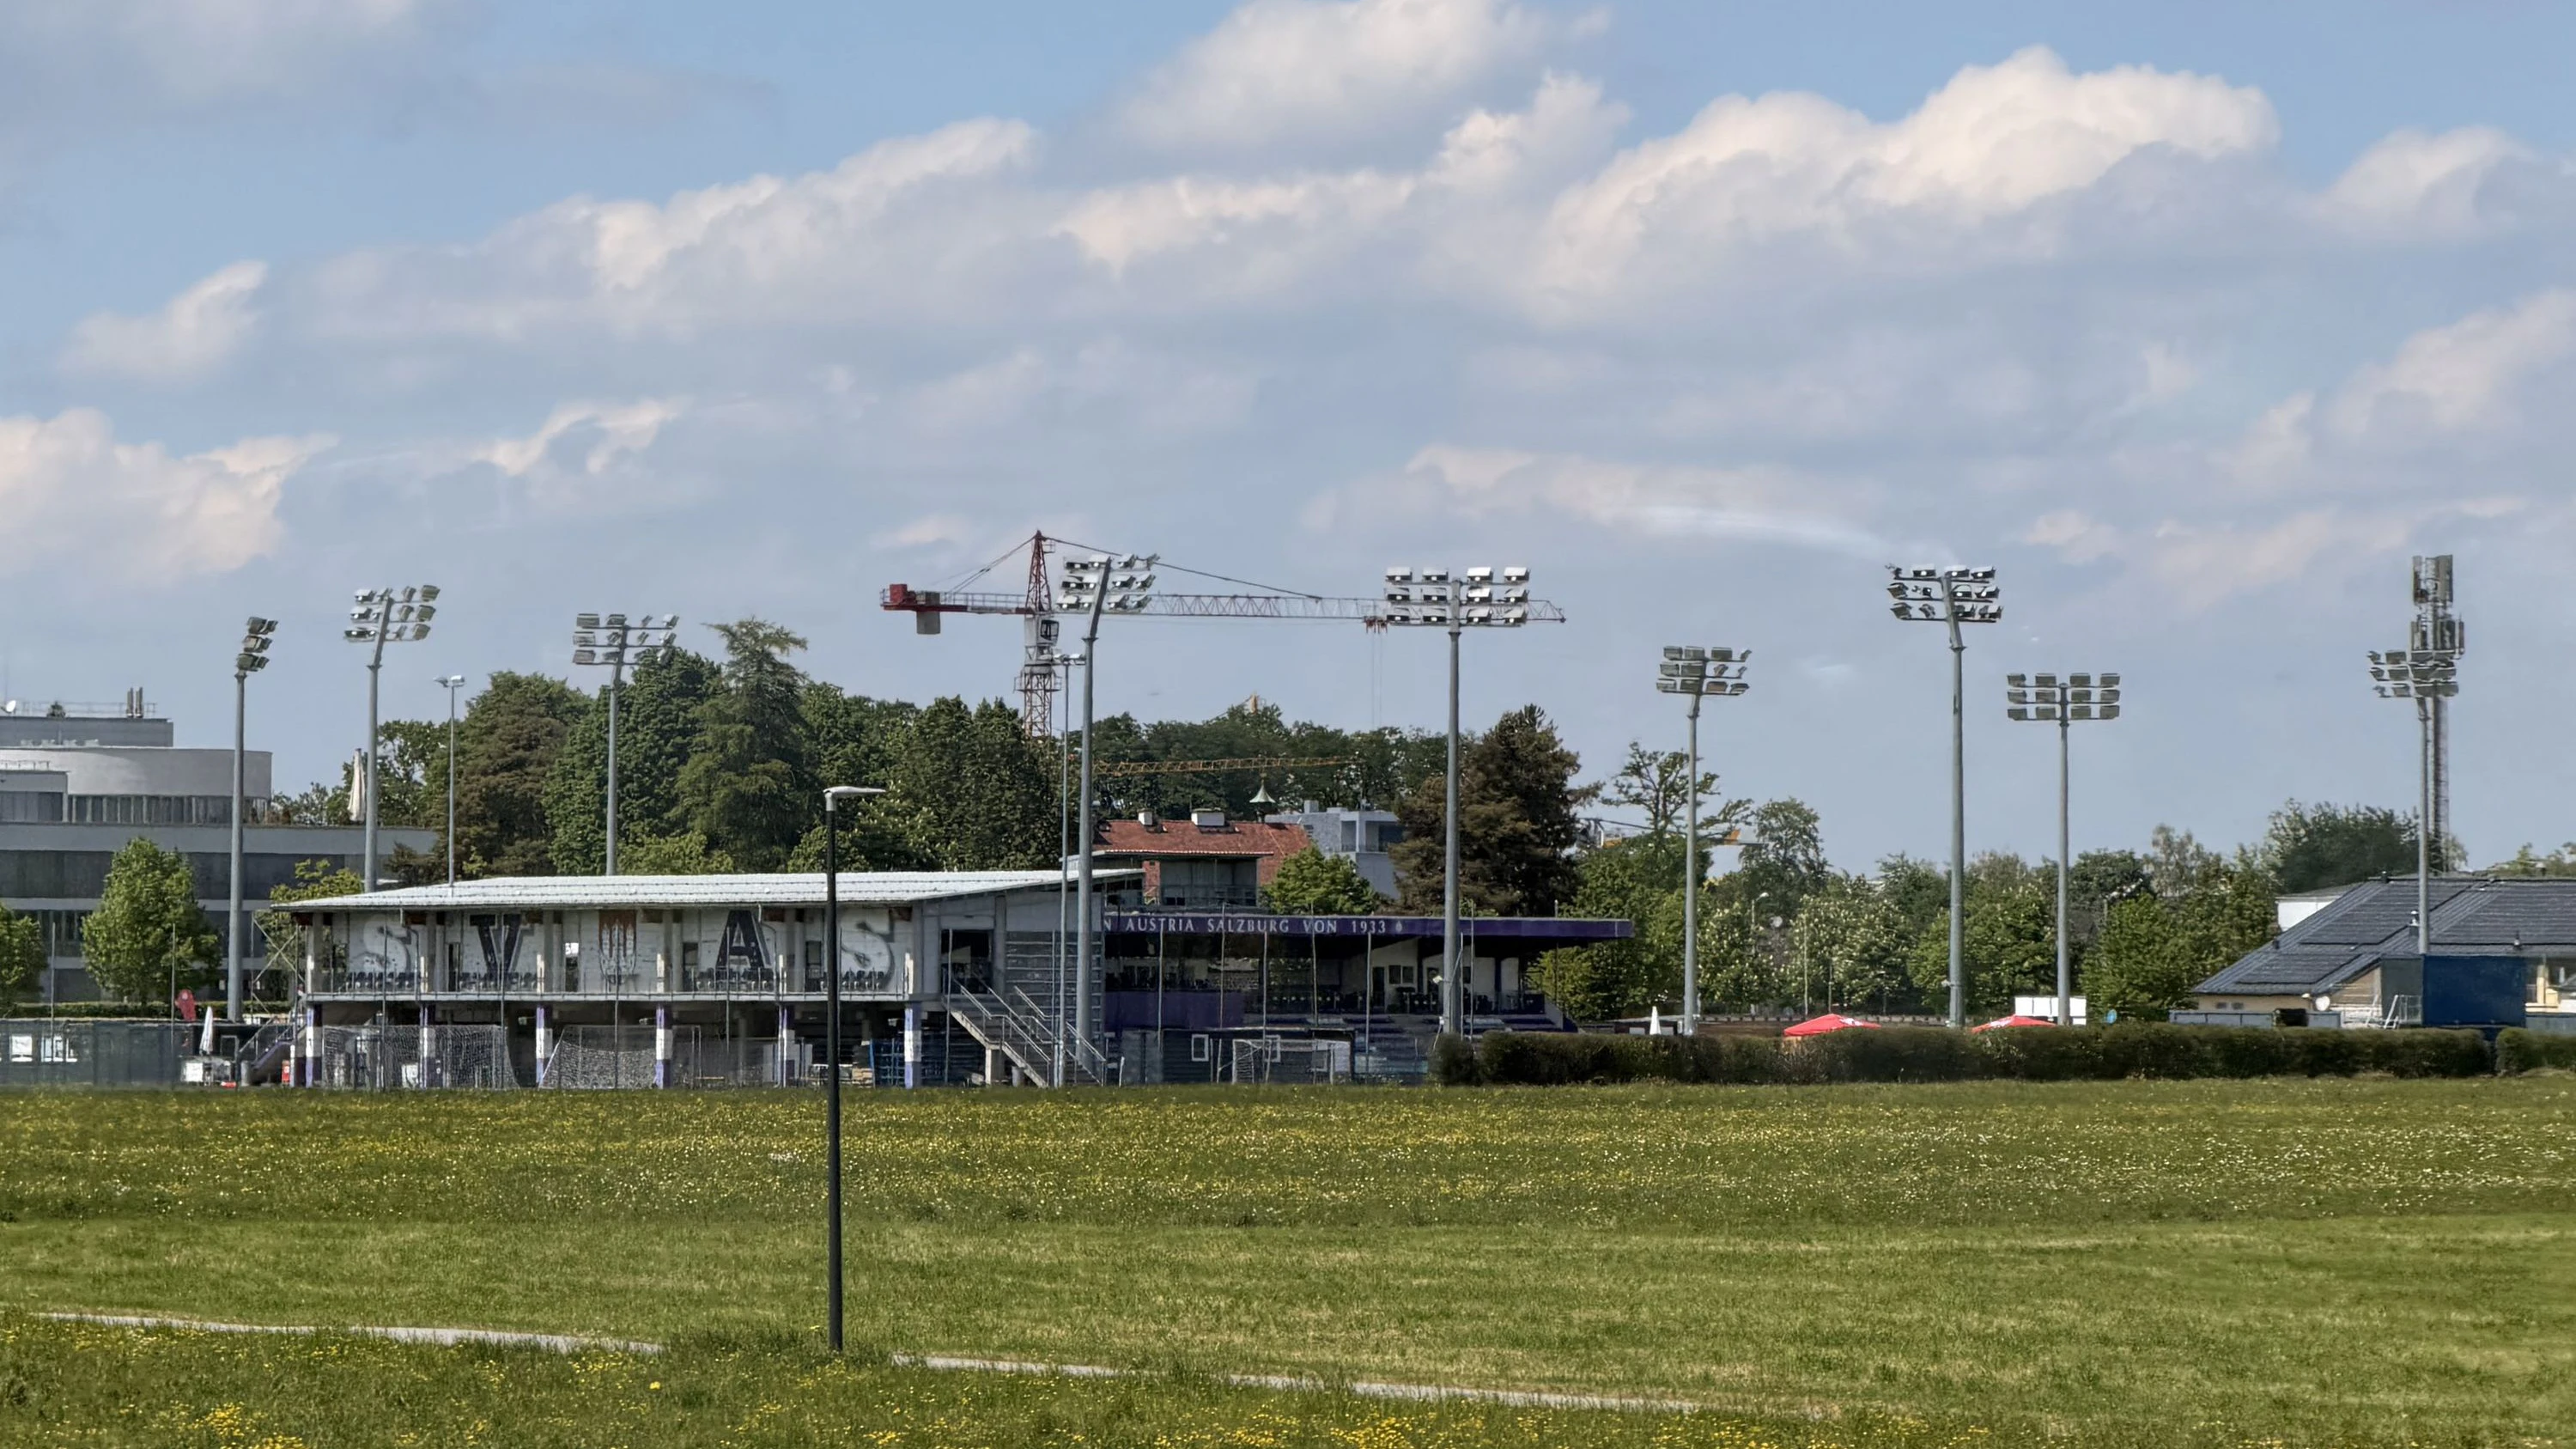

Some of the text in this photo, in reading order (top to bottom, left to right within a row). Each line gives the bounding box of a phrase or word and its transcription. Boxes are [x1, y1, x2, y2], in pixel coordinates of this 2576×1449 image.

[470, 913, 526, 985] V
[714, 910, 772, 979] A
[1125, 918, 1194, 933] AUSTRIA
[1206, 918, 1289, 933] SALZBURG
[1302, 919, 1338, 934] VON
[1351, 920, 1387, 934] 1933
